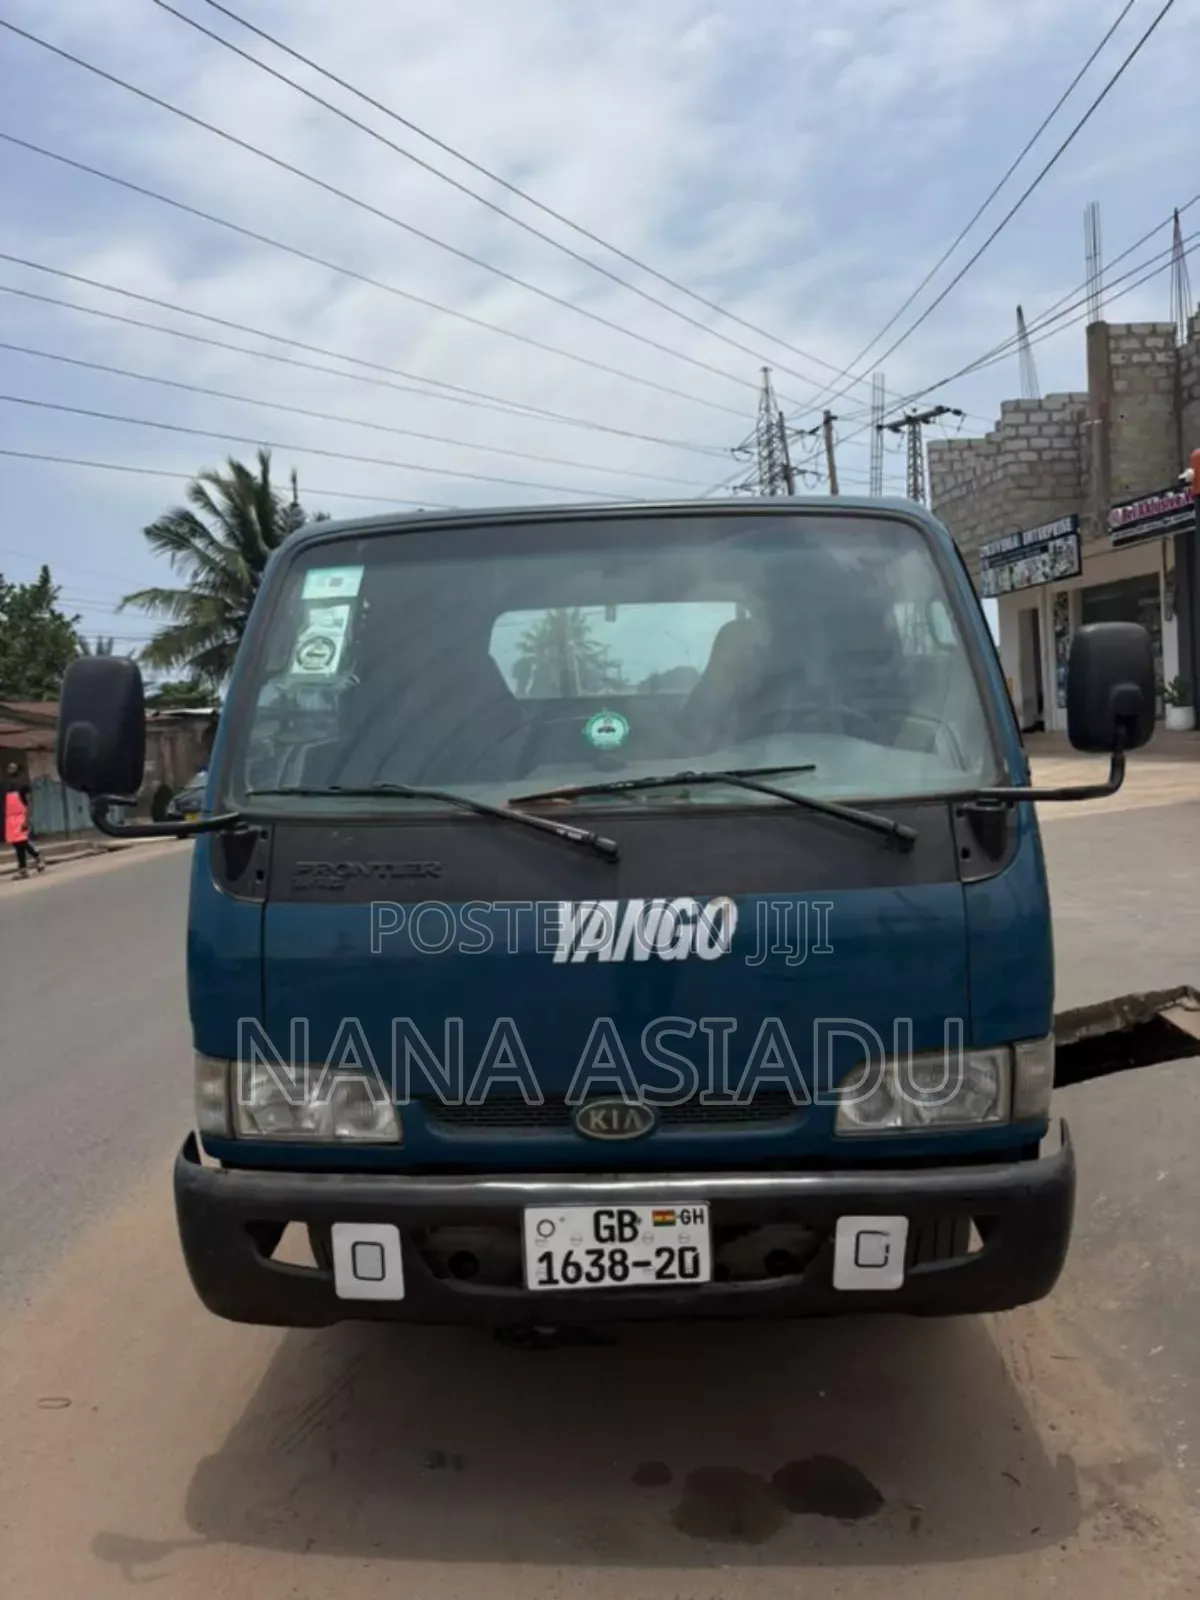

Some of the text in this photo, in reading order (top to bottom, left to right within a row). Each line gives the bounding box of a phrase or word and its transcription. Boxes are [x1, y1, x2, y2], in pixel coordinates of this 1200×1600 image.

[552, 896, 739, 963] YANGO
[588, 1108, 643, 1130] KIA
[593, 1208, 705, 1244] GB GH
[537, 1246, 700, 1286] 1638-20
